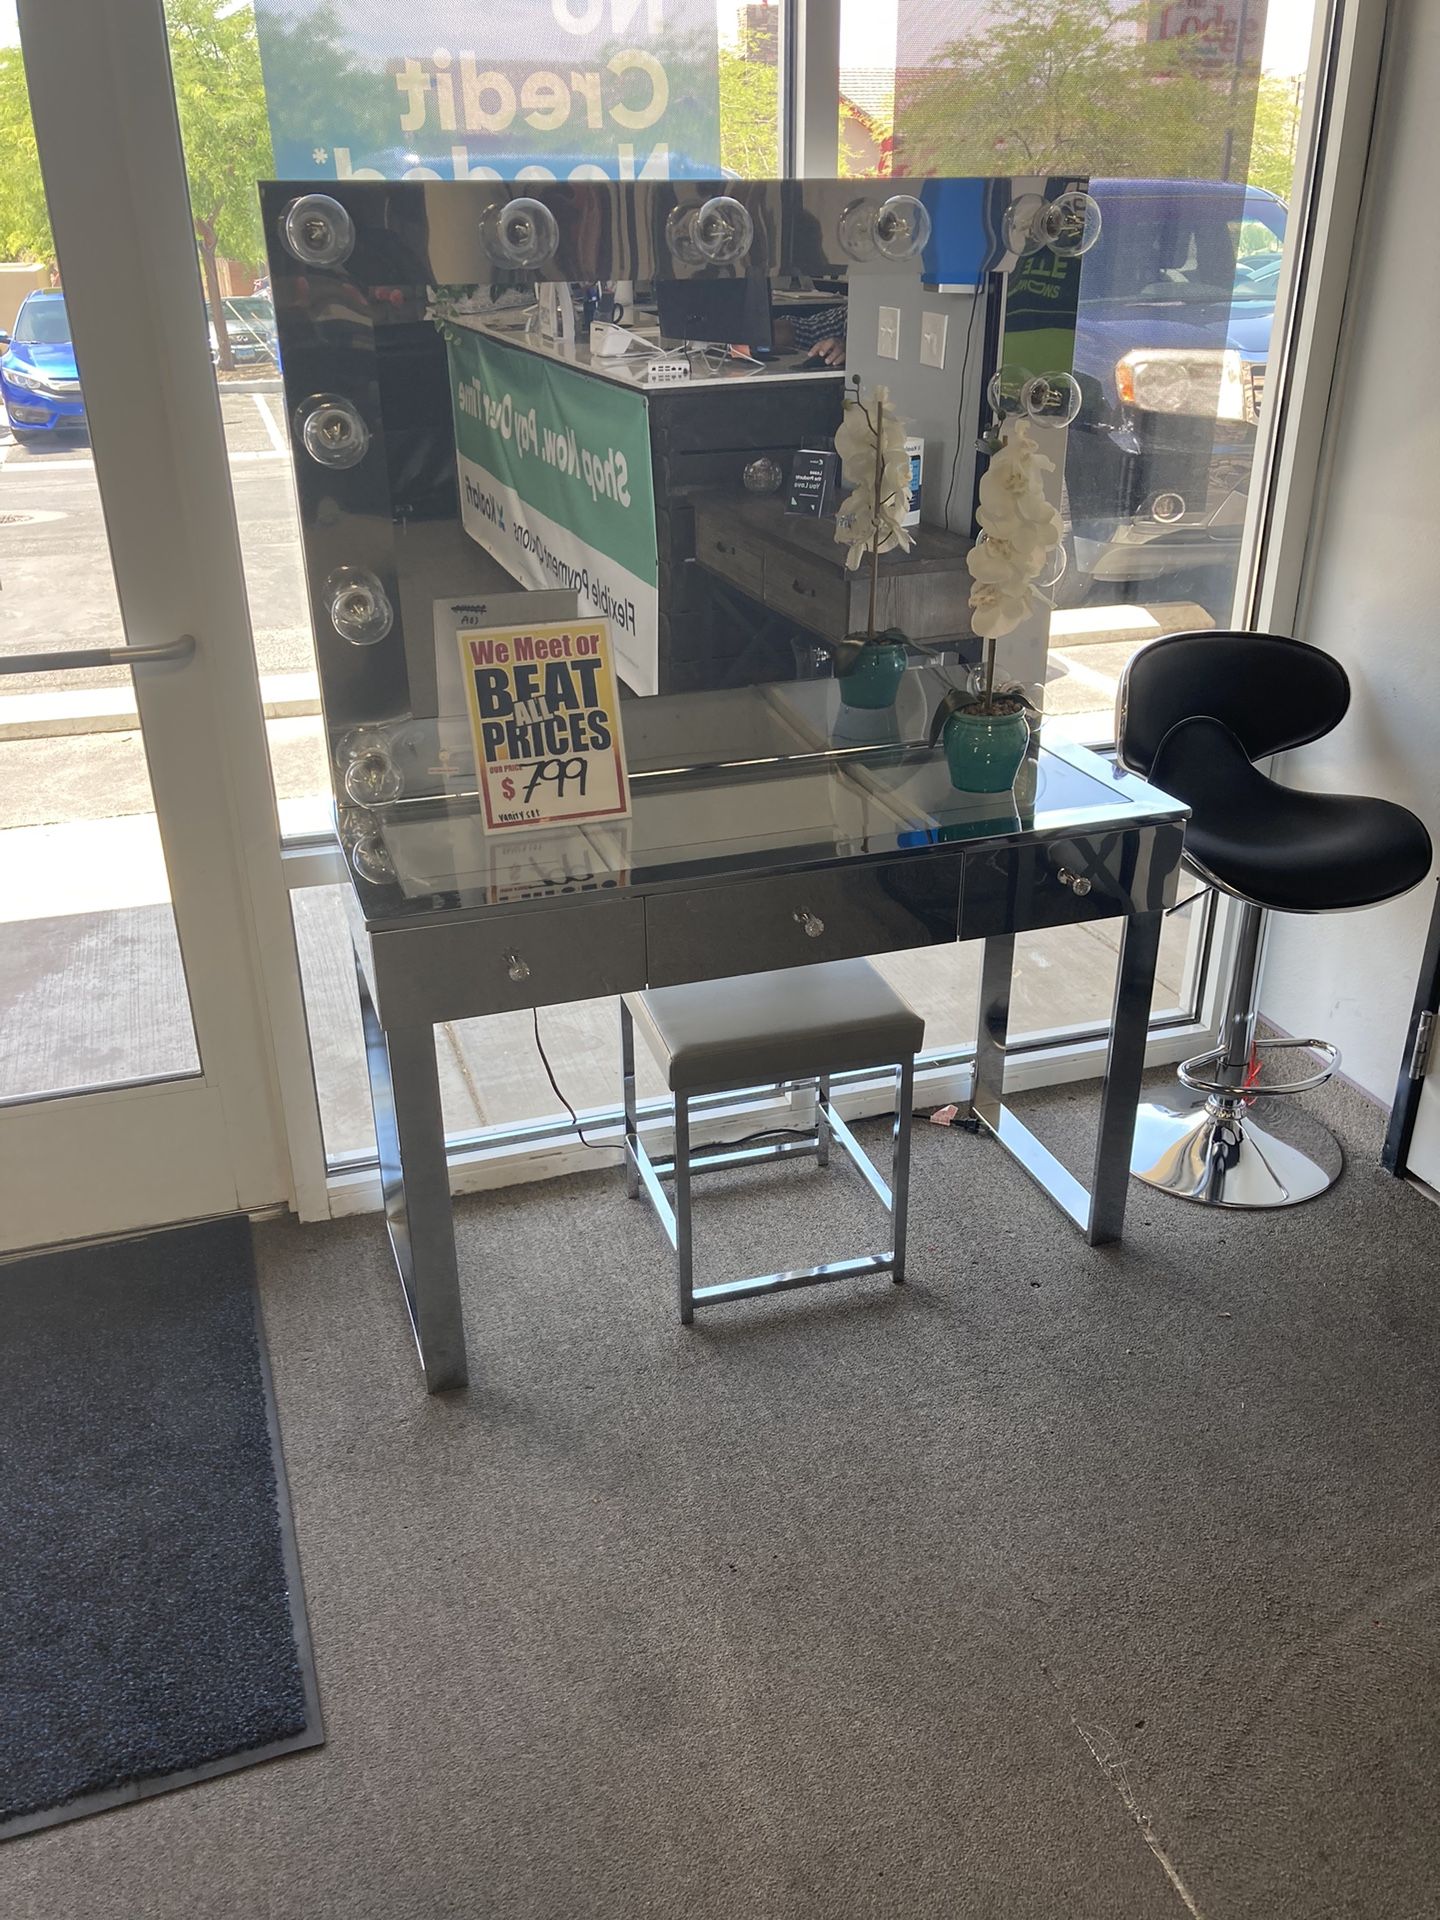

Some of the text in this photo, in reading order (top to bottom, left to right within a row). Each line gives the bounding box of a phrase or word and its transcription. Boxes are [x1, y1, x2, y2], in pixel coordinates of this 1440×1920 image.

[470, 634, 599, 666] We Meet or
[474, 658, 602, 719] BEAT
[513, 697, 553, 727] ALL
[482, 710, 612, 763] PRICES
[490, 764, 503, 774] OUR
